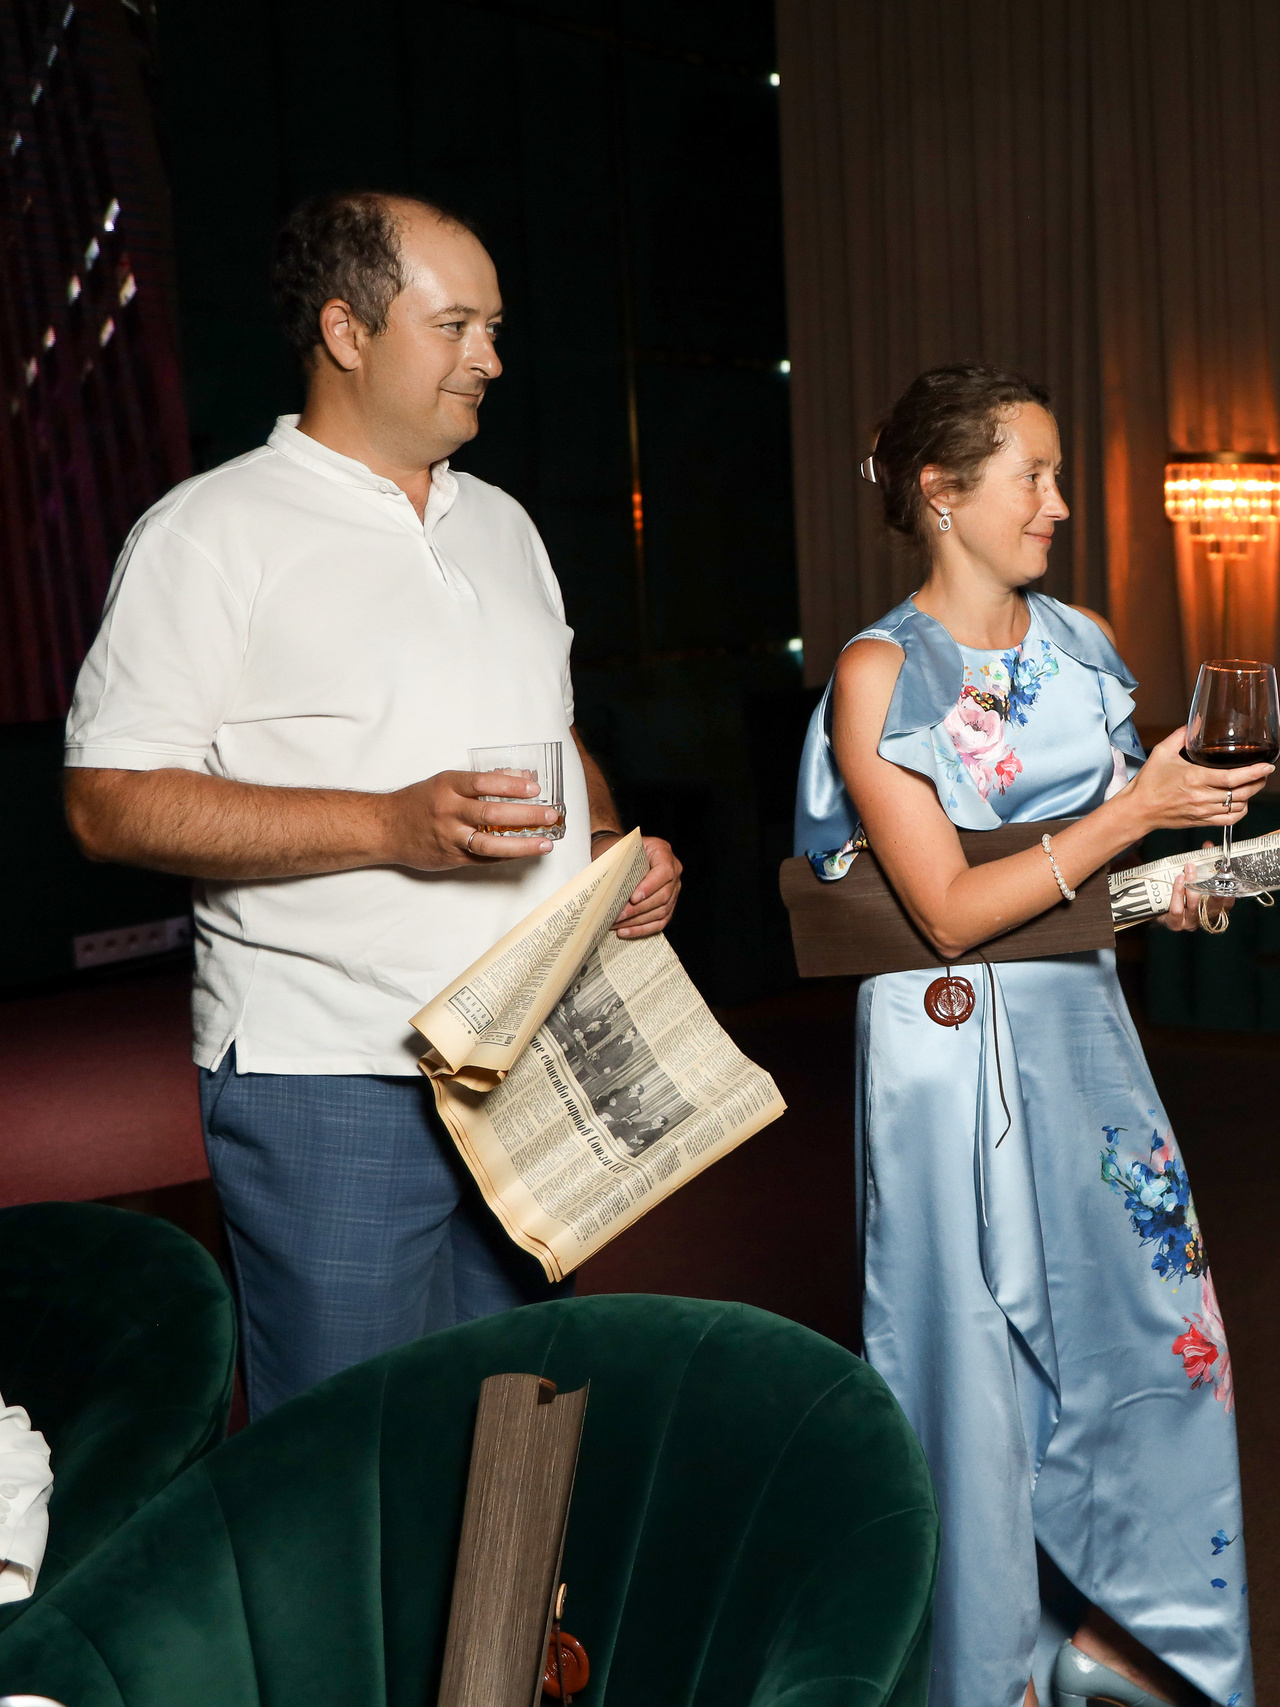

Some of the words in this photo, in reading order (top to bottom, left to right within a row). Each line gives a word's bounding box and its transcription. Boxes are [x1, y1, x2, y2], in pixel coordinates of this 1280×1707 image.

[541, 1053, 569, 1099] единство
[564, 1098, 593, 1136] народов
[587, 1135, 613, 1167] Союза
